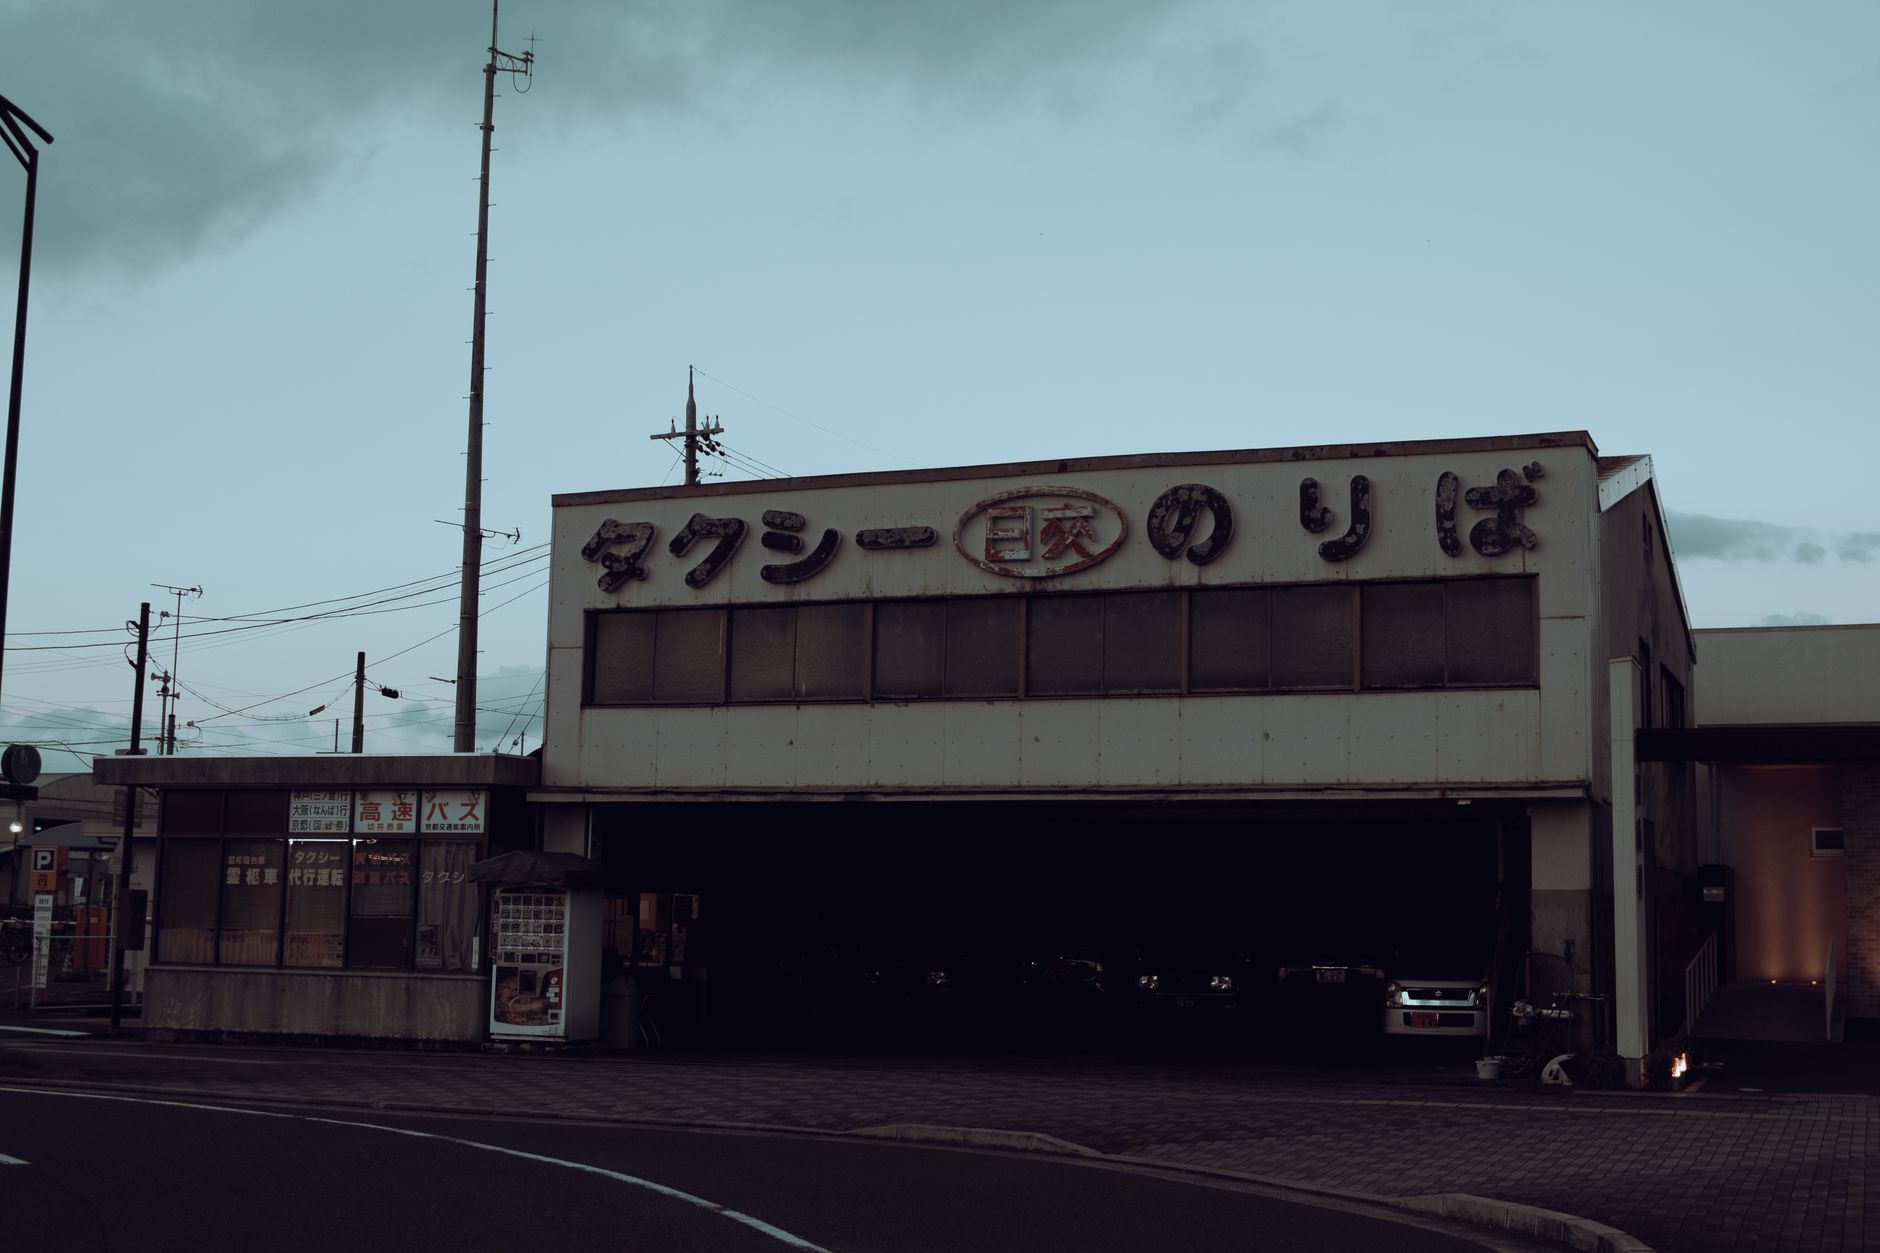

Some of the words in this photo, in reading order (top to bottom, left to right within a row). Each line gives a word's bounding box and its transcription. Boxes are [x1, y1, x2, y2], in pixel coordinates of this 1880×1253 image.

[581, 509, 938, 593] タクシー
[1147, 461, 1544, 566] のりば
[360, 801, 413, 821] 高速
[426, 801, 479, 821] バス
[37, 851, 52, 870] P
[295, 851, 341, 864] タクシー
[289, 868, 344, 886] 代行運転
